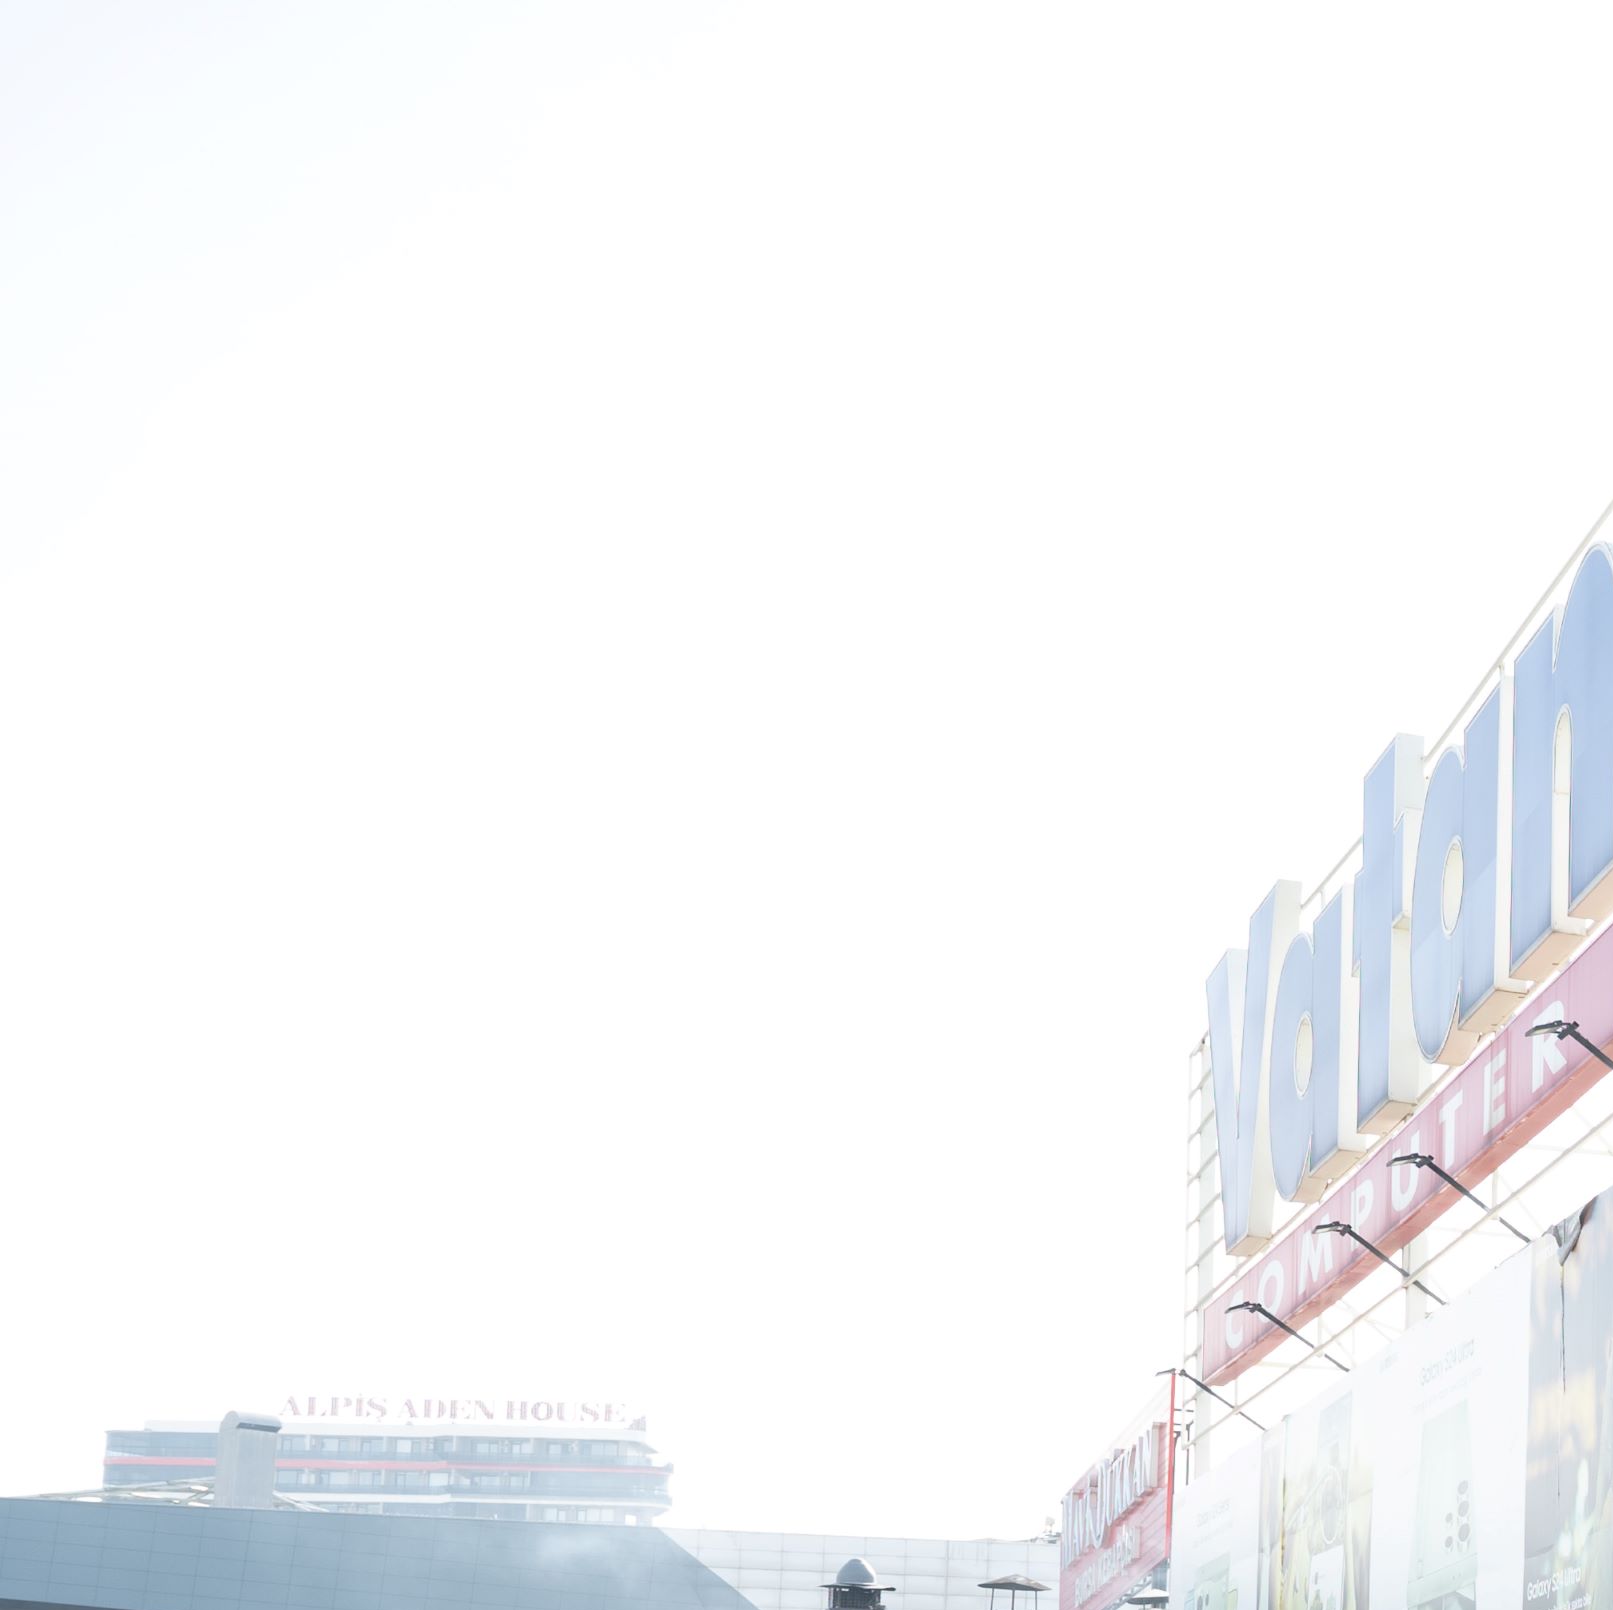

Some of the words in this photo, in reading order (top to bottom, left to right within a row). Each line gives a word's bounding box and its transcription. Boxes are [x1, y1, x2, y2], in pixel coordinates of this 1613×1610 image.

[1223, 1000, 1567, 1350] COMPUTER
[398, 1398, 495, 1420] ADEN
[505, 1399, 628, 1423] HOUSE
[1527, 1578, 1551, 1600] Galaxy
